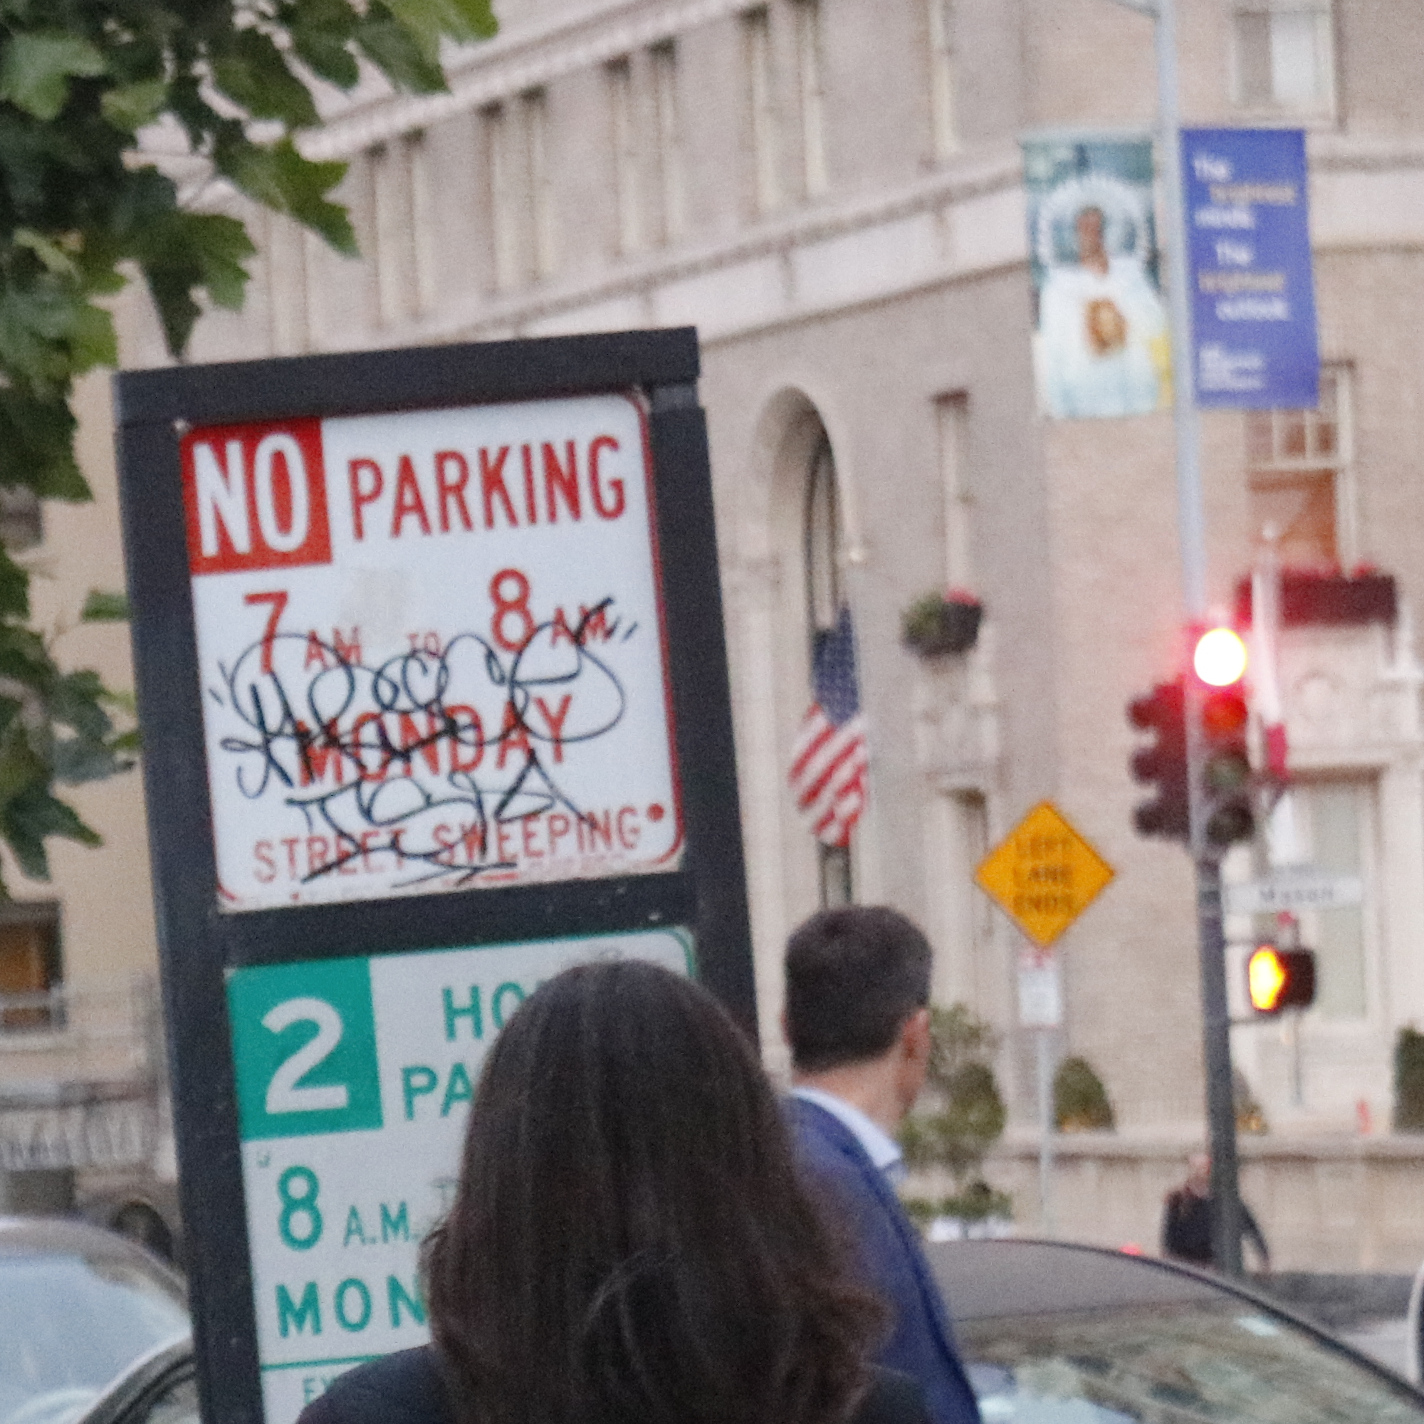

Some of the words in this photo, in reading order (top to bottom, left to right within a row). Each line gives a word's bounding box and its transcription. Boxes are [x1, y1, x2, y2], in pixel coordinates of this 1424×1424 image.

[190, 431, 313, 559] NO
[347, 434, 626, 541] PARKING
[244, 590, 289, 674] 7
[305, 626, 362, 671] AM
[489, 568, 535, 652] 8
[551, 604, 611, 649] AM
[295, 693, 572, 787] MONDAY
[253, 829, 408, 884] STREET
[432, 805, 640, 868] SWEEPING
[259, 996, 349, 1115] 2
[443, 981, 541, 1041] HO
[277, 1164, 324, 1251] 8
[274, 1273, 428, 1339] MON
